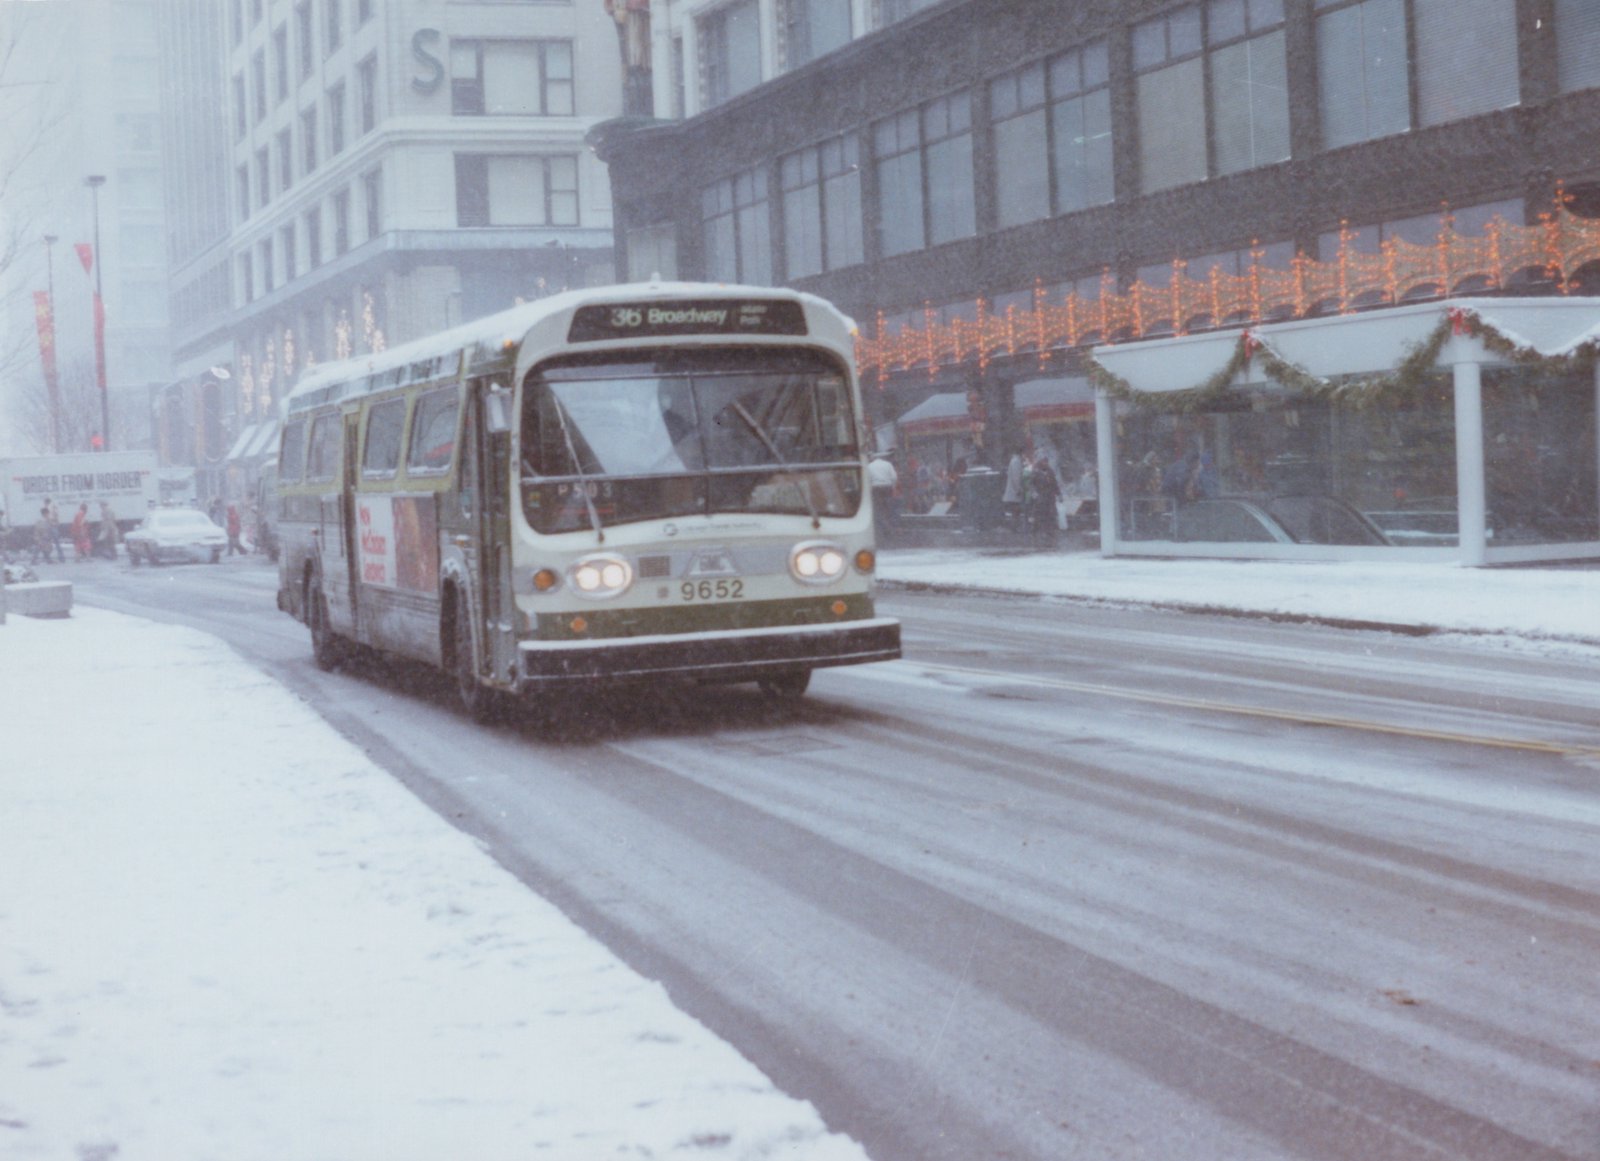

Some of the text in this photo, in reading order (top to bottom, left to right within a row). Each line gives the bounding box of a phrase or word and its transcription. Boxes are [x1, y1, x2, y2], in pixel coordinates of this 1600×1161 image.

[410, 27, 445, 96] S
[610, 308, 728, 327] 36 Broadway
[22, 475, 59, 494] ORDER
[62, 473, 94, 492] FROM
[681, 579, 744, 601] 9652
